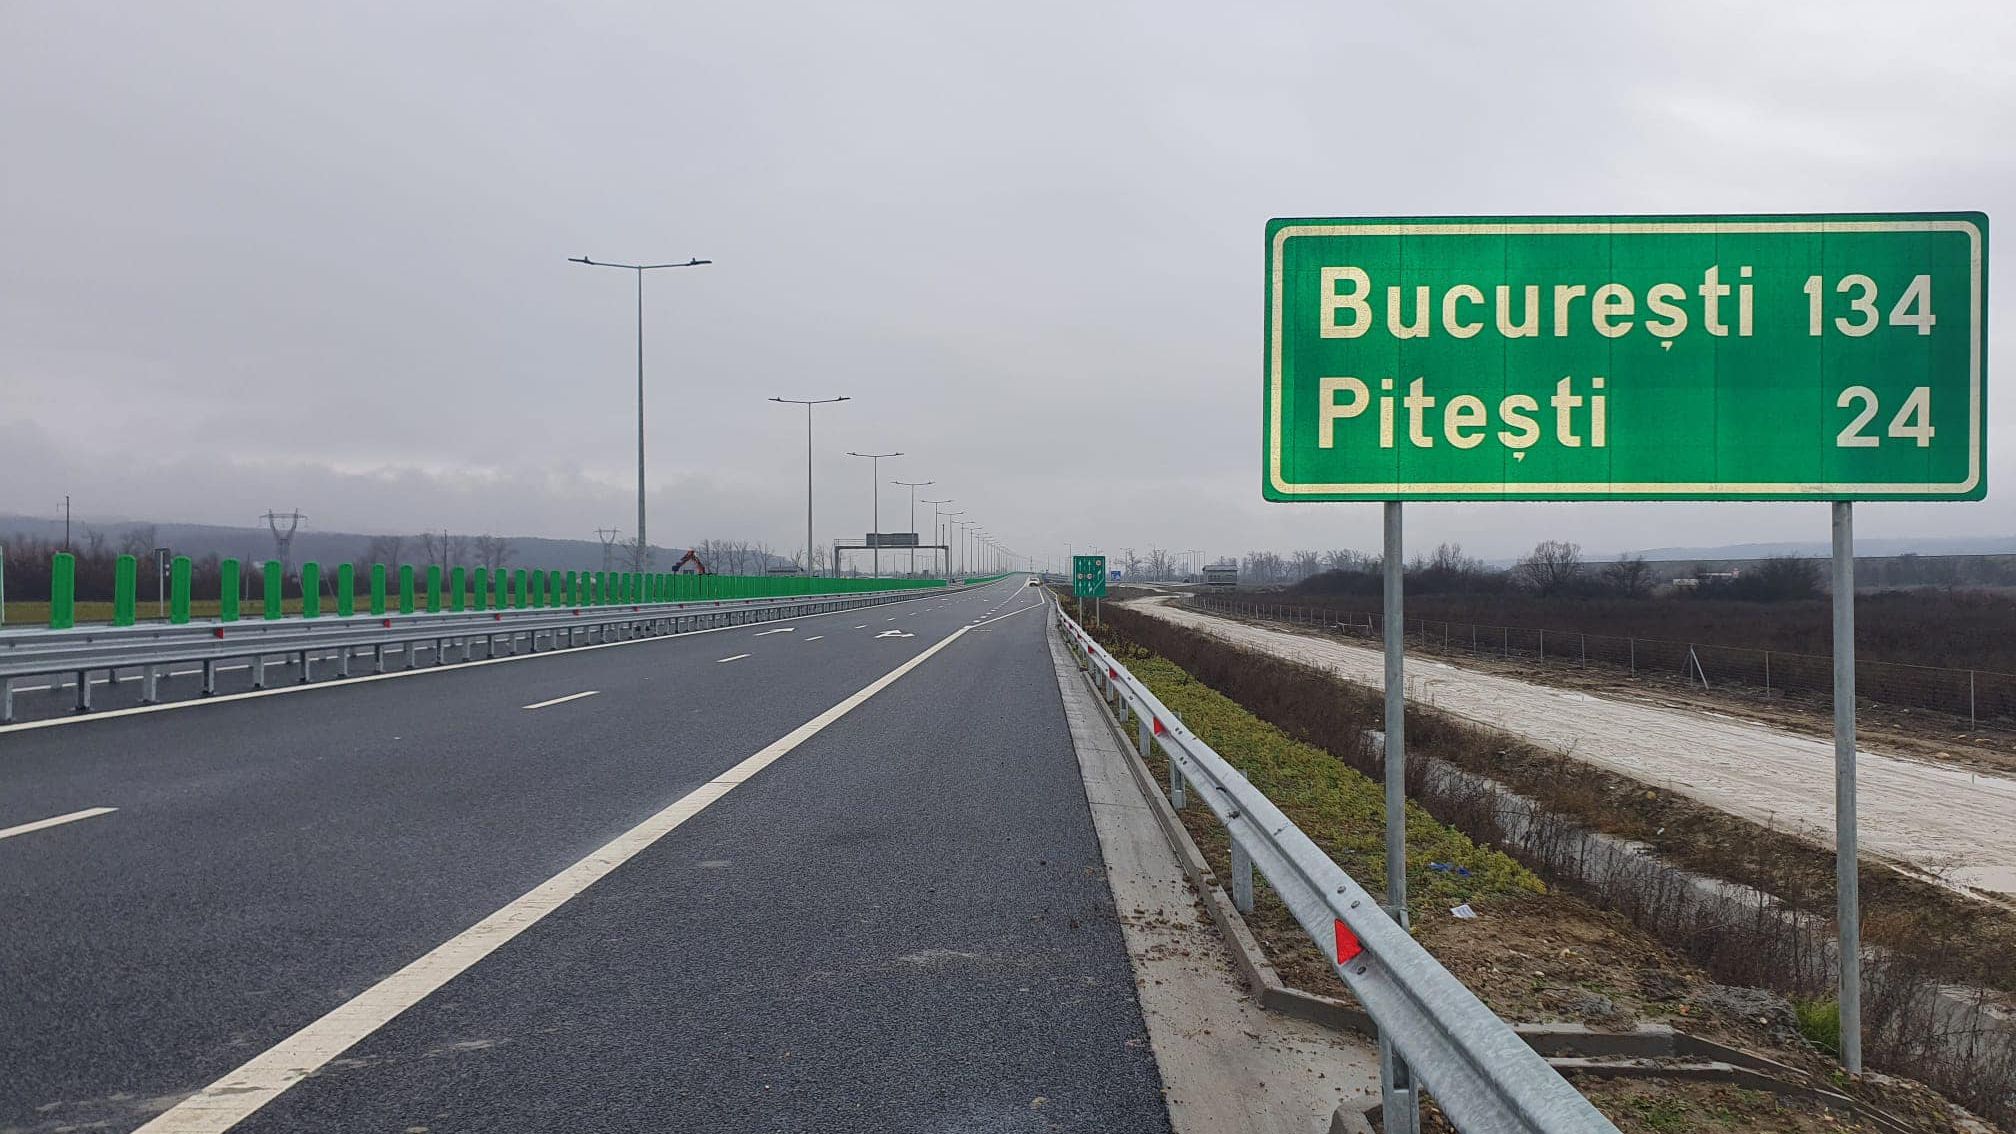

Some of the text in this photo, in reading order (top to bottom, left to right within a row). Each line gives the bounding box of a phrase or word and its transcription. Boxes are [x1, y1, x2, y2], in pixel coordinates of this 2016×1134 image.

[1319, 265, 1936, 351] București 134
[1318, 376, 1935, 462] Pitești 24
